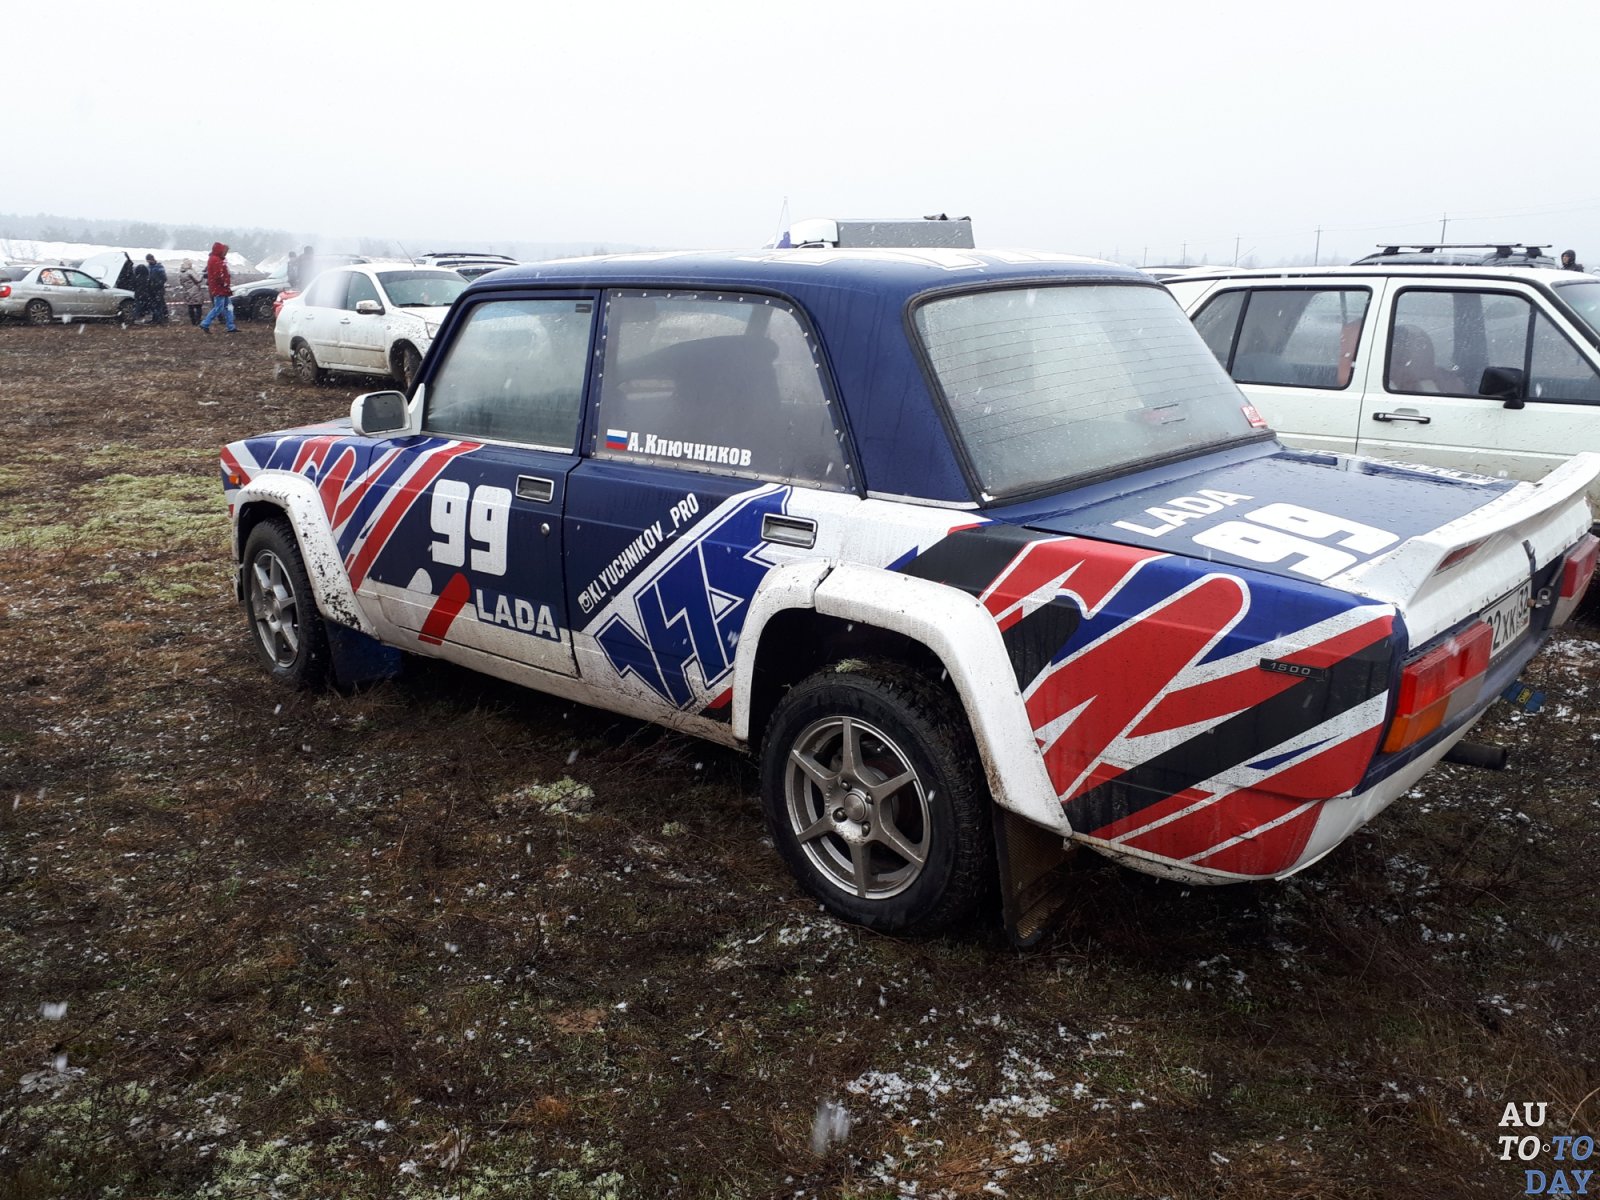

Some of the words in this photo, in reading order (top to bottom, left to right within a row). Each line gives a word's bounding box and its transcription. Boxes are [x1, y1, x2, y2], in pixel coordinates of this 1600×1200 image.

[627, 432, 752, 466] А.Ключников
[430, 479, 512, 576] 99
[1111, 488, 1255, 538] LADA
[587, 492, 700, 605] KLYUCHNIKOV_PRO
[1191, 502, 1400, 581] 99
[476, 589, 559, 639] LADA
[1270, 662, 1311, 675] 1500
